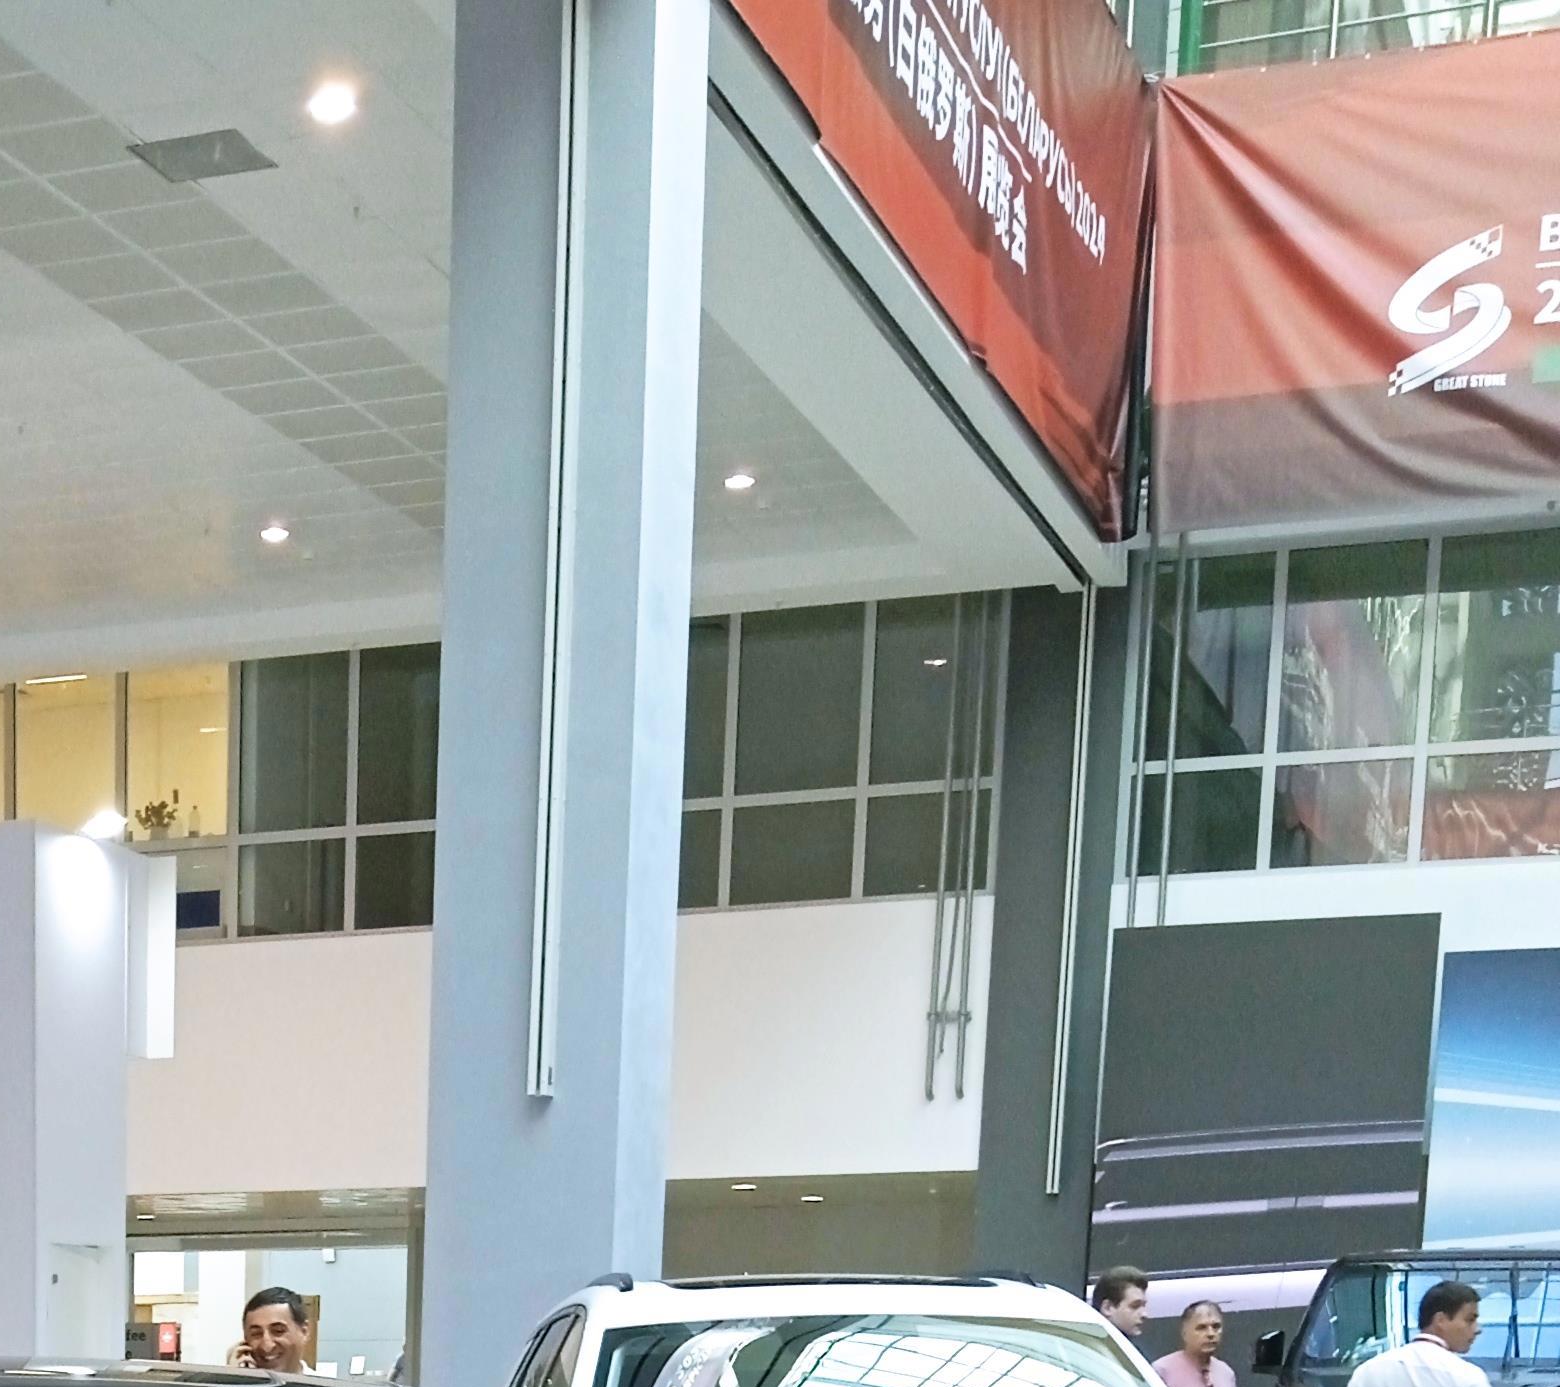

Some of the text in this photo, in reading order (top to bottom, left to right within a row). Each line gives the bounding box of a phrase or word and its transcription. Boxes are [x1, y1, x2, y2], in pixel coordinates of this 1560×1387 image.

[1075, 180, 1106, 266] 2024
[1434, 373, 1507, 392] GREAT STONE
